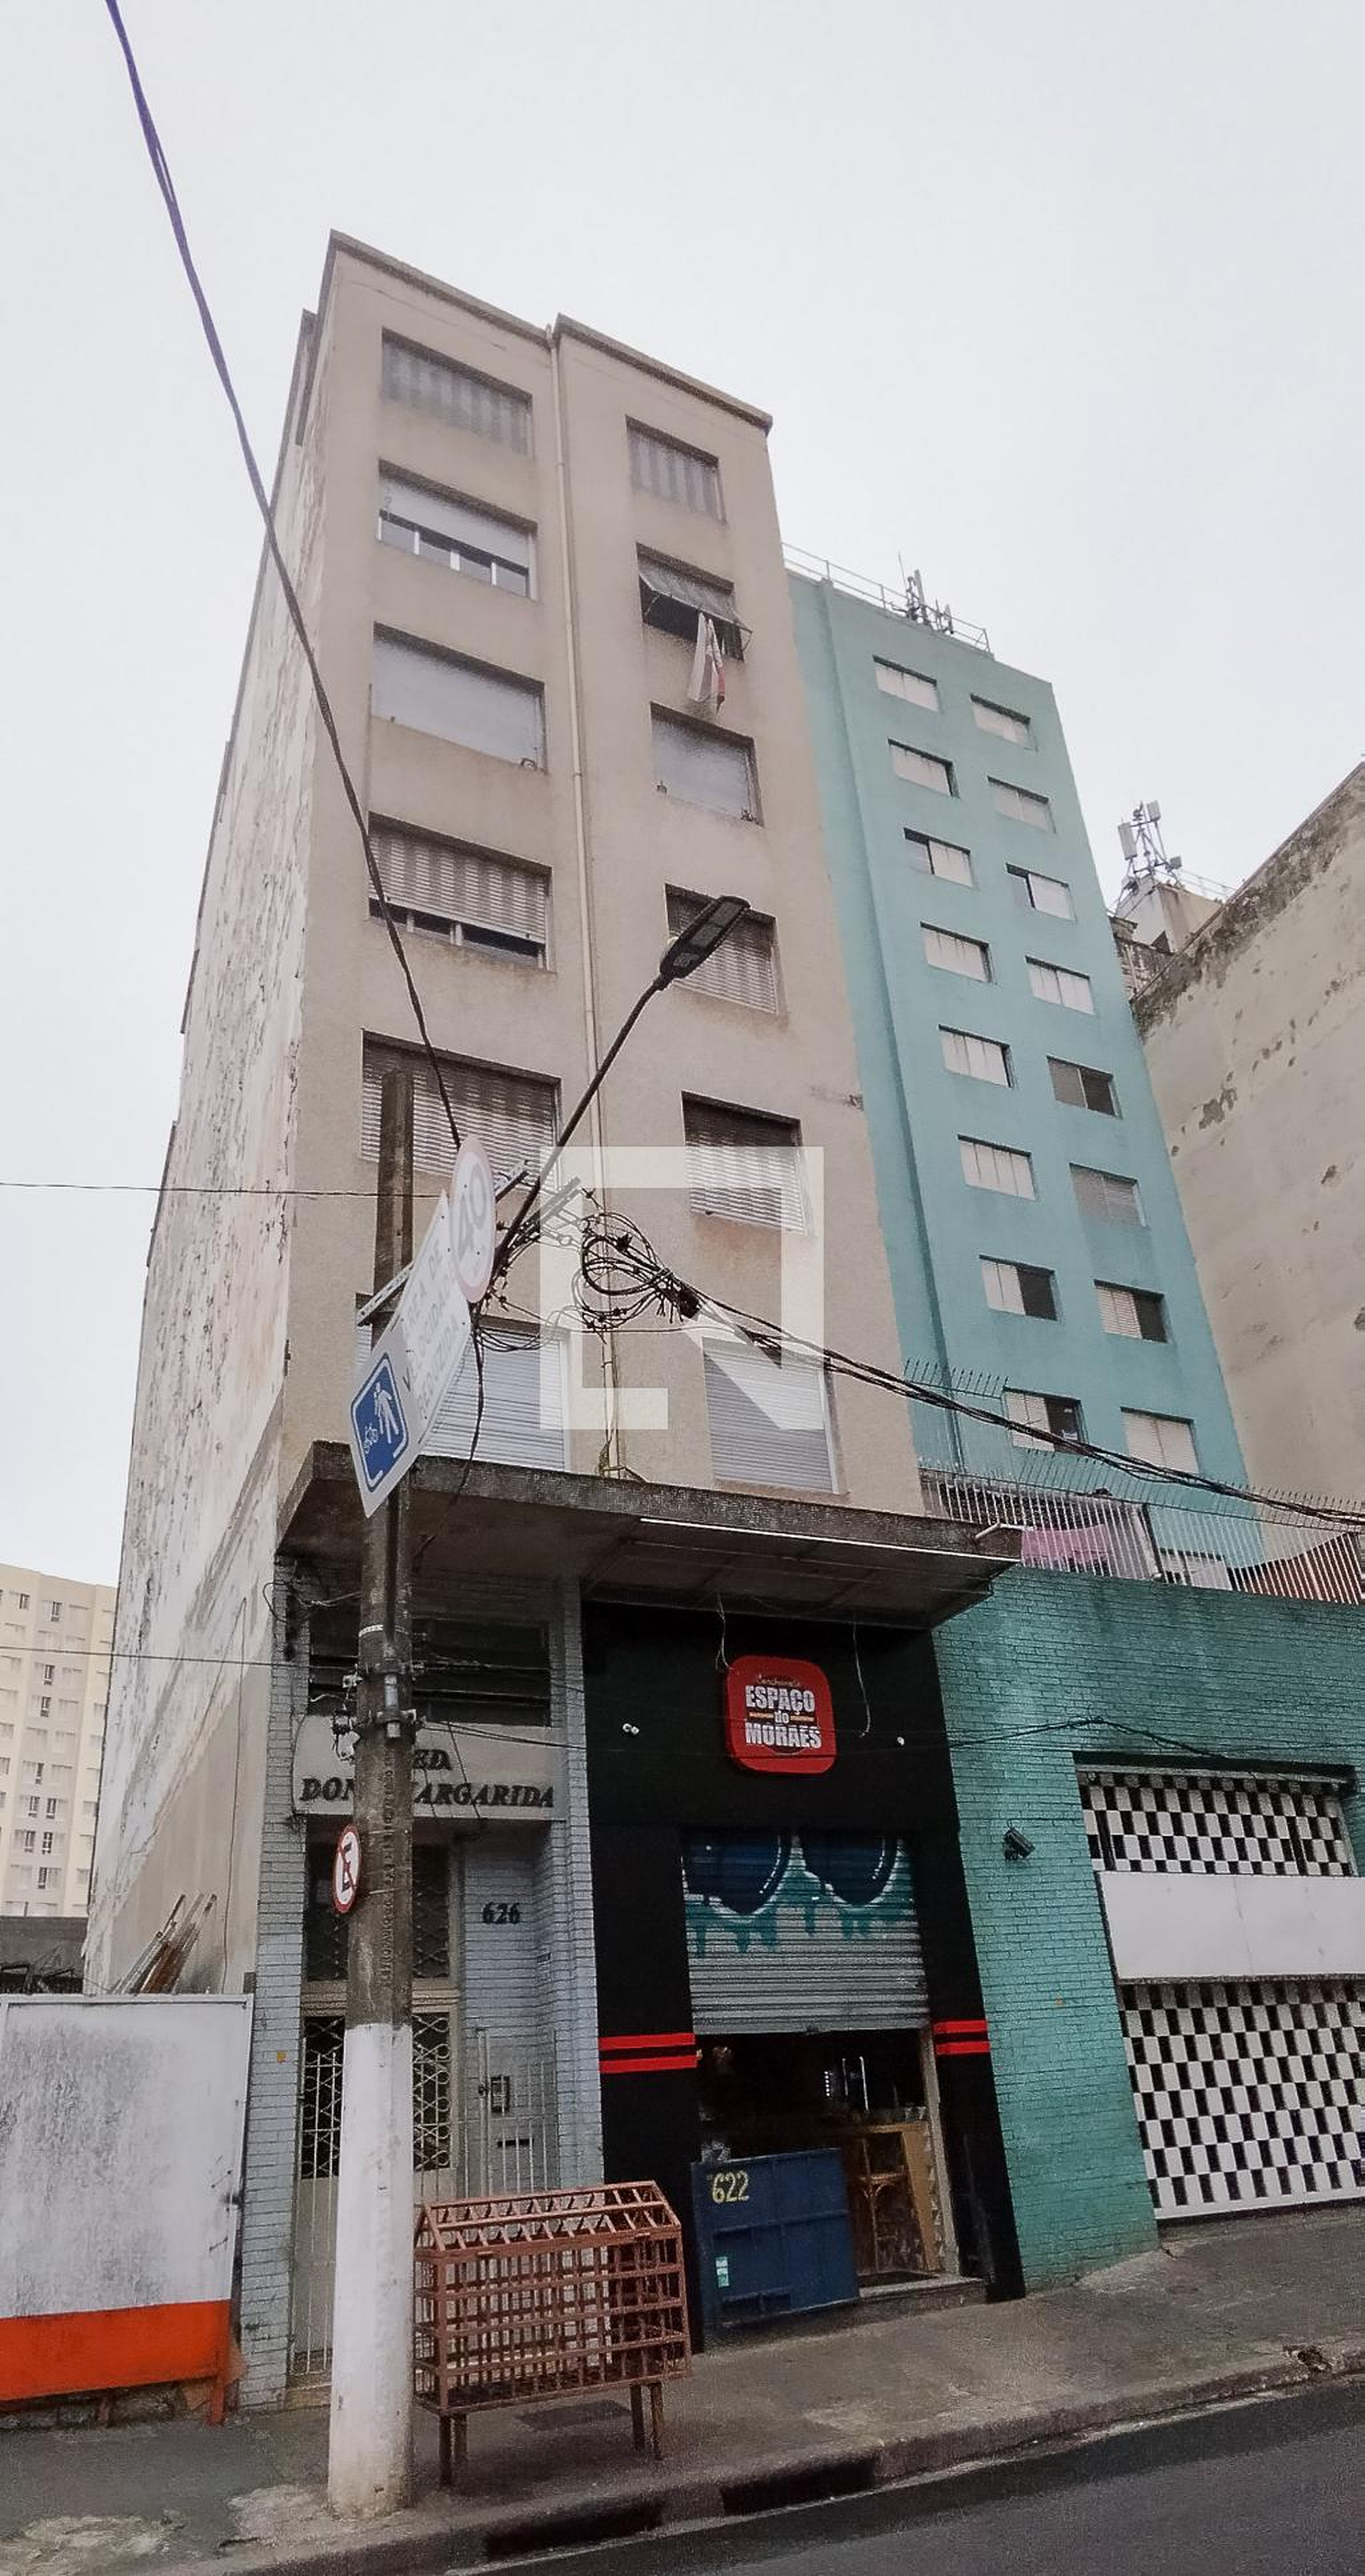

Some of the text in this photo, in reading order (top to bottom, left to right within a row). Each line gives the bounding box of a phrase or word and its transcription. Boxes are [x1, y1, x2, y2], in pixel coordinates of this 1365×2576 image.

[458, 1163, 487, 1261] 40
[745, 1685, 815, 1715] ESPAÇO
[774, 1710, 790, 1724] do
[745, 1722, 822, 1749] MORAES
[298, 1777, 554, 1807] DON ARGARIDA
[483, 1902, 521, 1924] 626
[712, 2170, 750, 2204] 622
